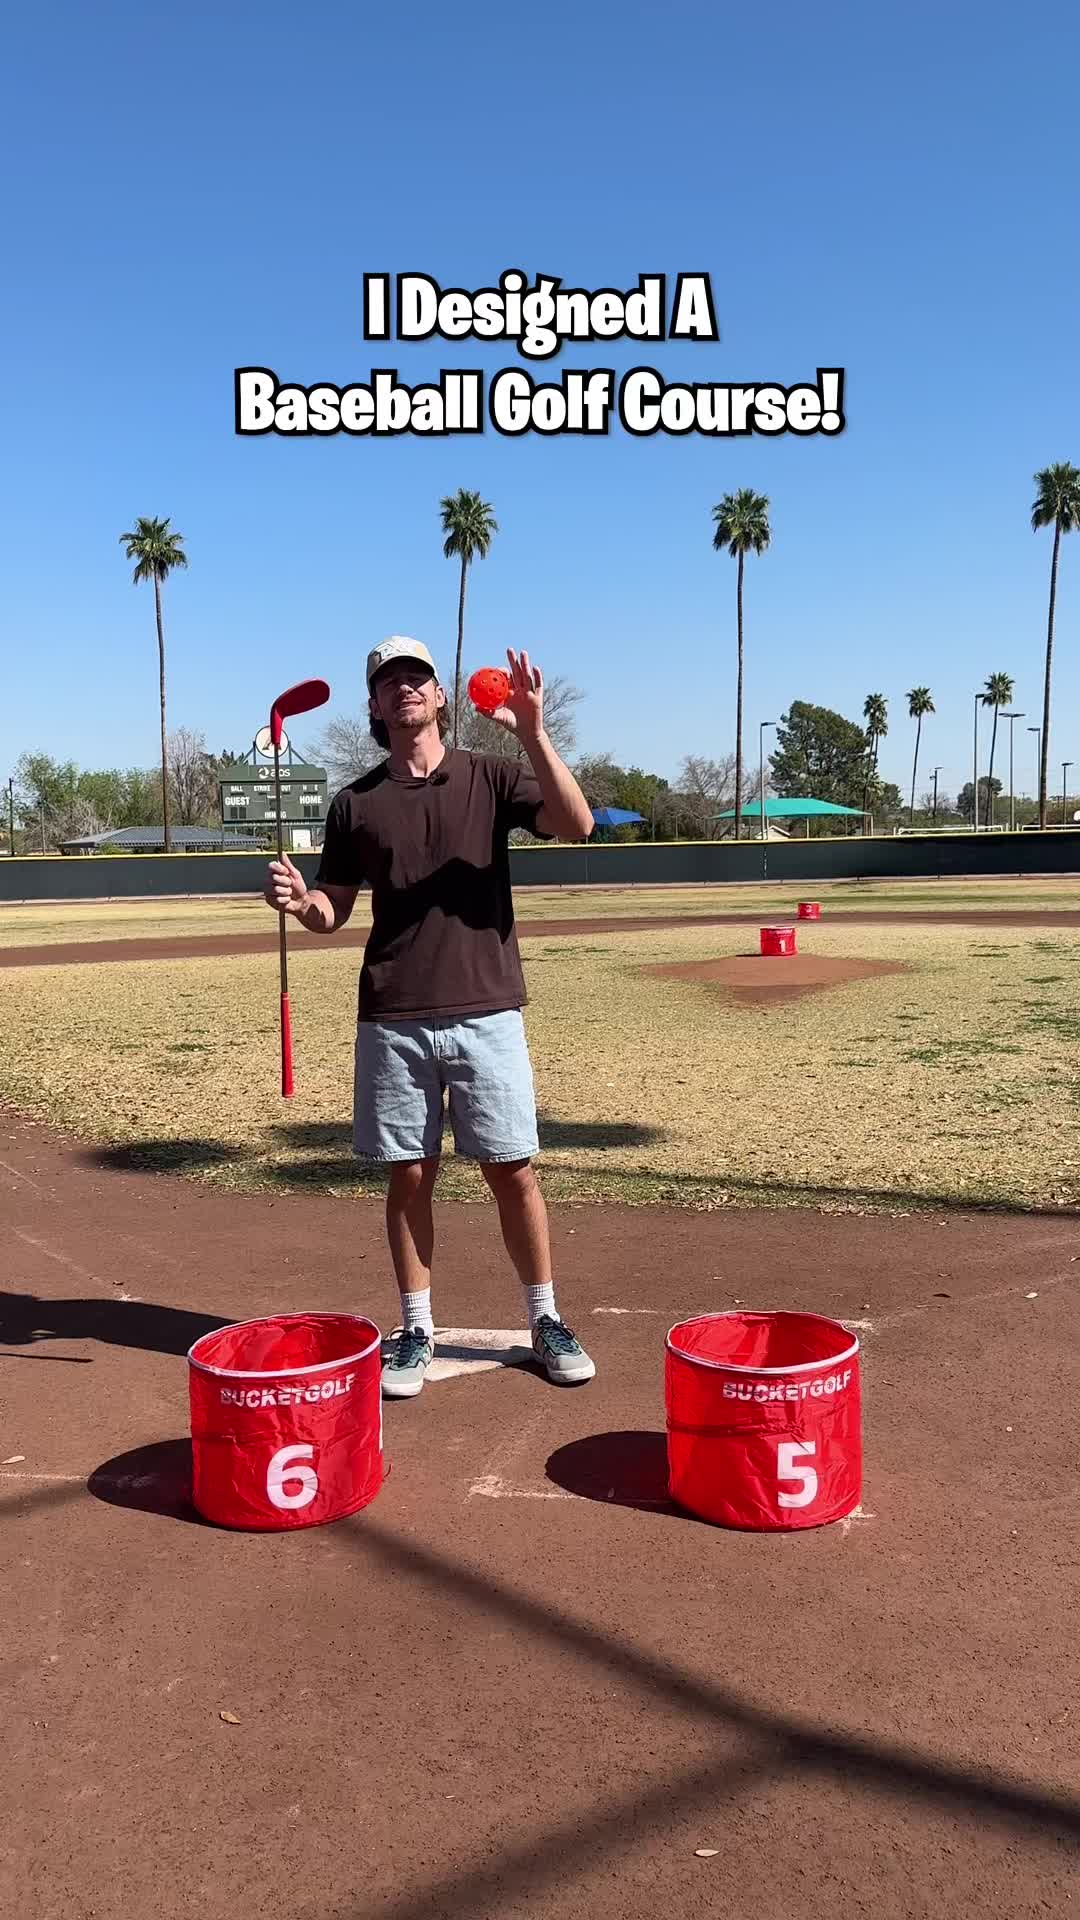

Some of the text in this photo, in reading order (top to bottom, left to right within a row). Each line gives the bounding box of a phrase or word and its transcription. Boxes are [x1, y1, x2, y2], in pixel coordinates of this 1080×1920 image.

[225, 795, 323, 806] GUEST HOME
[779, 940, 786, 953] 1
[220, 1373, 356, 1408] BUCKETGOLF
[722, 1369, 852, 1403] BUCKETGOLF
[266, 1444, 318, 1510] 6
[777, 1440, 819, 1508] 5
